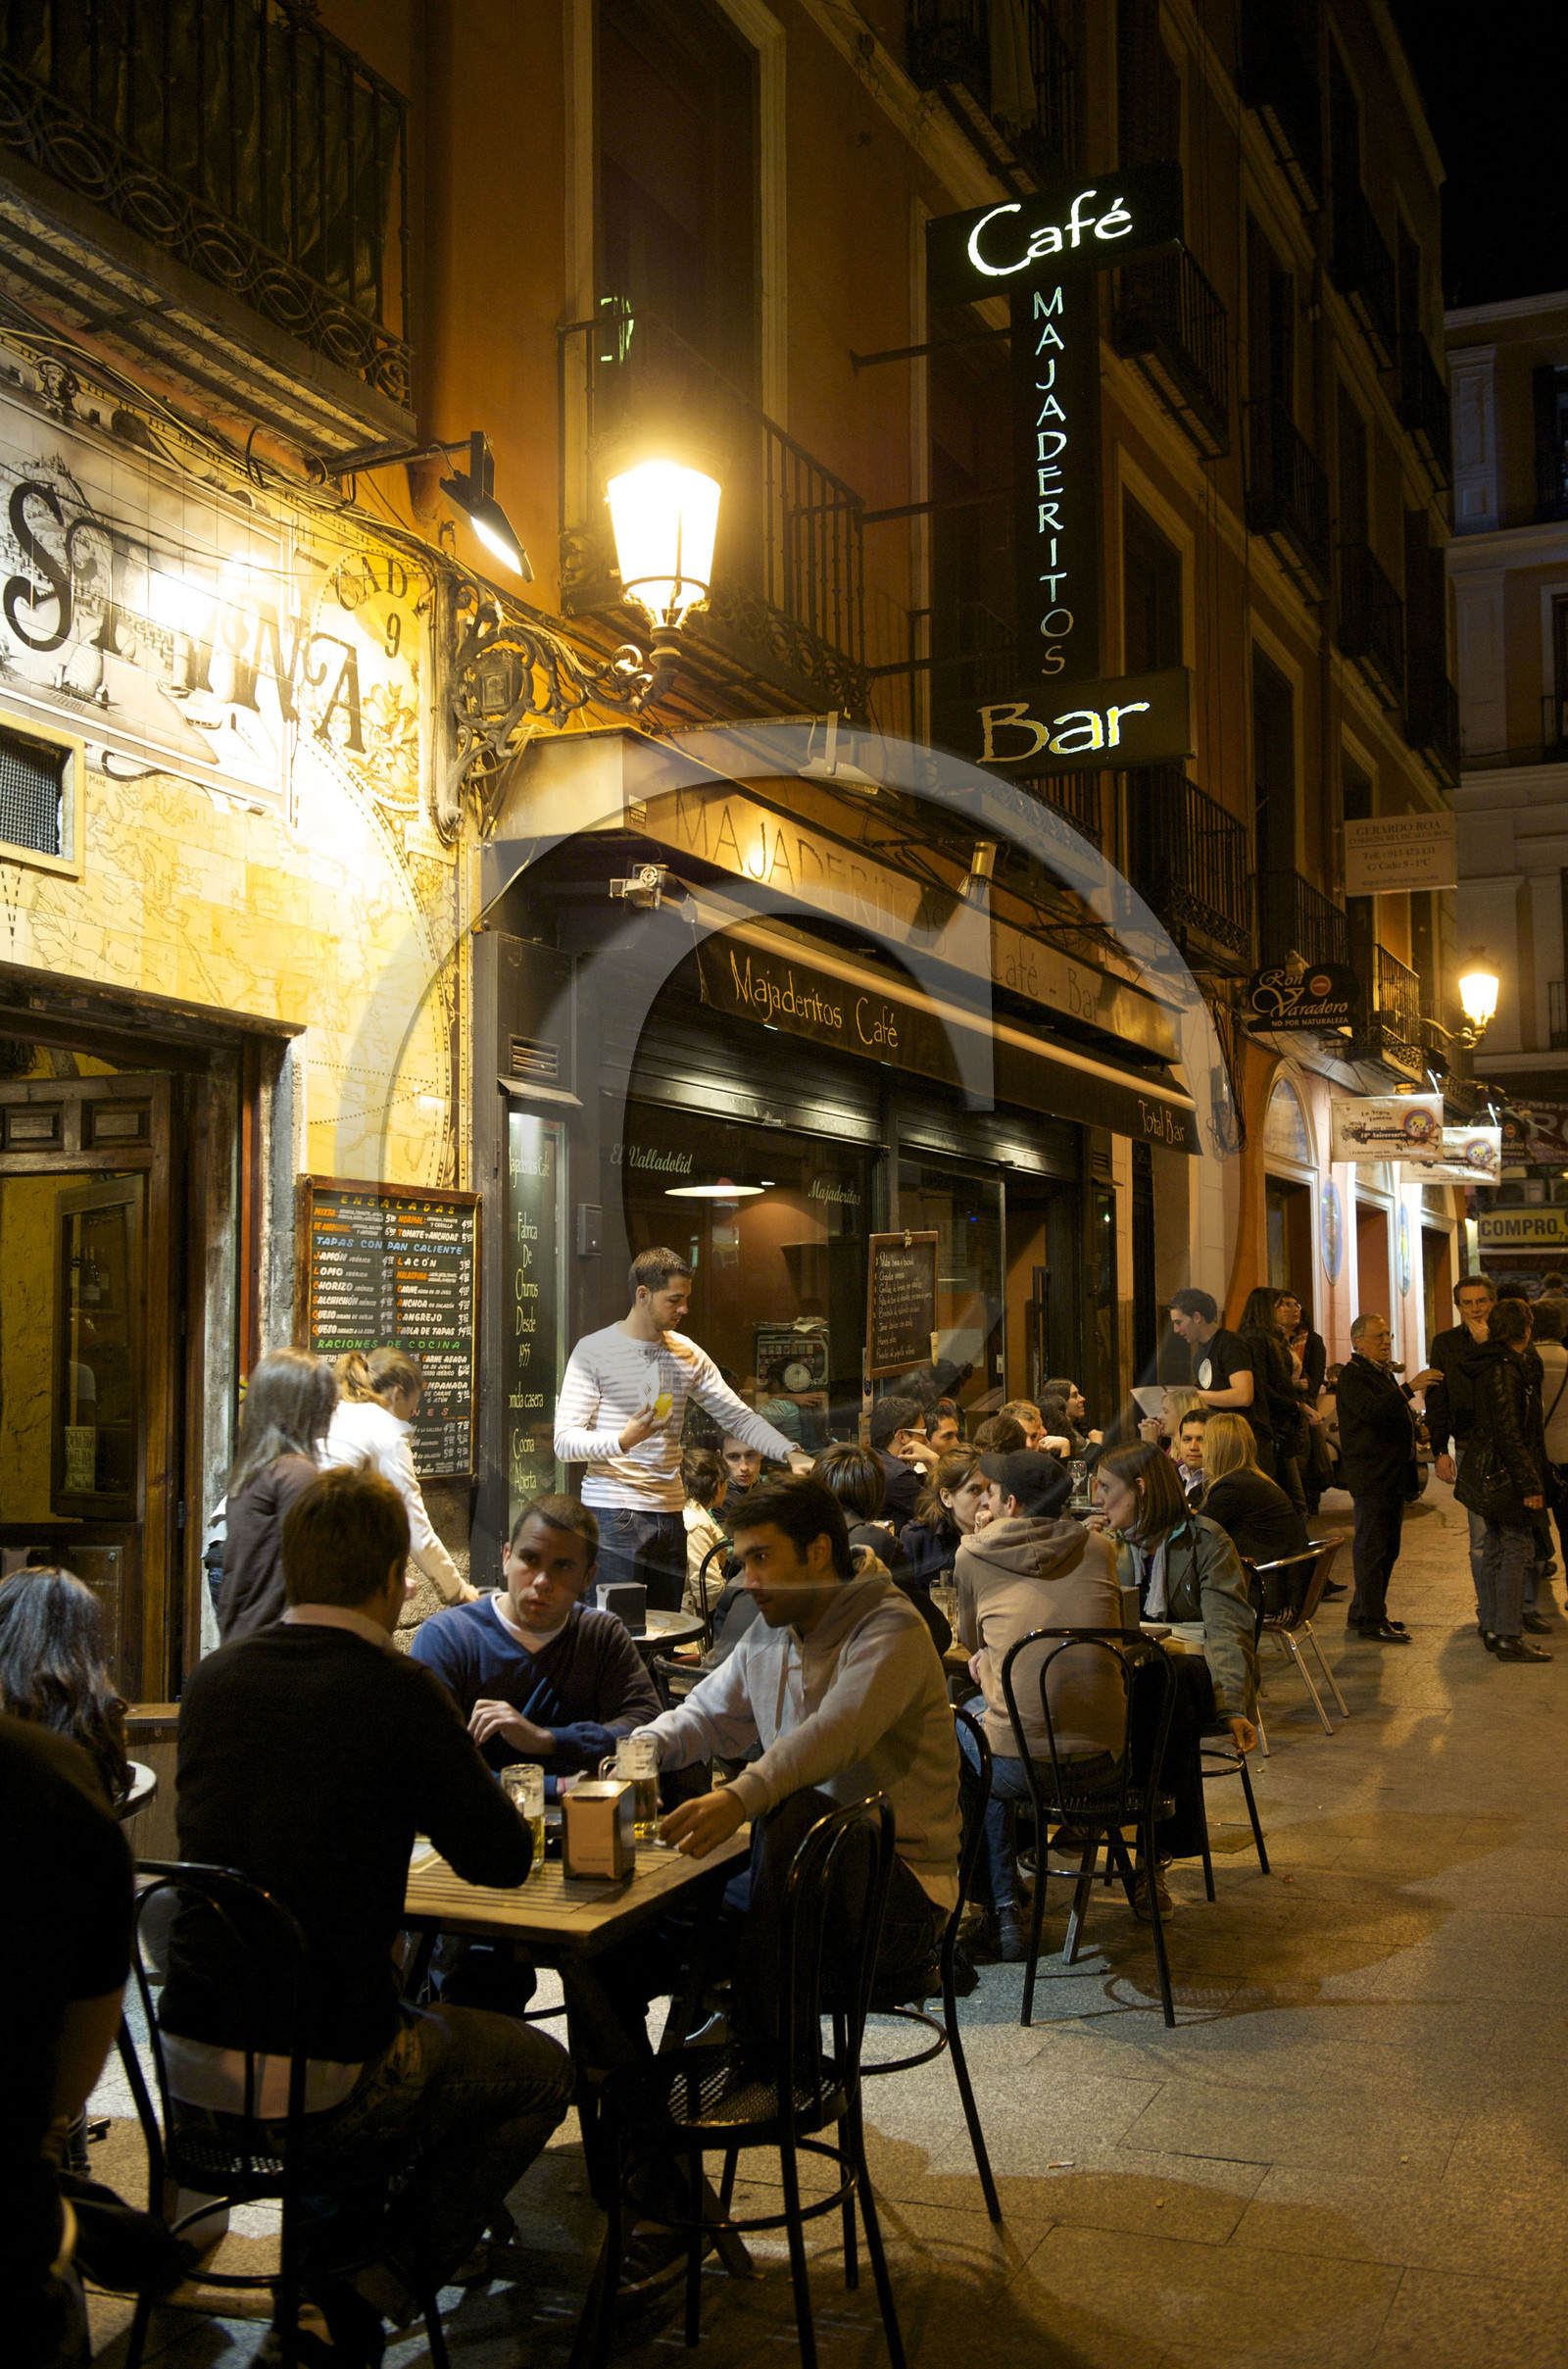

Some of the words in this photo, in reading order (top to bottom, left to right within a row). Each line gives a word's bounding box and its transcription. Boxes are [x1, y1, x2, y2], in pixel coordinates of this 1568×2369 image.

[966, 188, 1134, 277] Café
[1032, 285, 1074, 676] MAJADERITOS
[384, 612, 402, 659] 9
[975, 701, 1152, 765] Bar
[1416, 820, 1442, 831] ROA
[985, 932, 1039, 998] Café
[1067, 965, 1101, 1022] Bar
[1258, 968, 1304, 988] Ron
[729, 949, 843, 1029] Majaderitos
[856, 997, 900, 1049] Café
[1251, 987, 1349, 1018] Varadero
[1285, 1018, 1299, 1027] POR
[1301, 1016, 1349, 1025] NATURALEZA
[1138, 1098, 1164, 1137] Total
[1165, 1110, 1186, 1145] Bar
[610, 1143, 625, 1165] El
[628, 1145, 694, 1175] Valladolid
[808, 1179, 862, 1207] Majaderitos
[340, 1195, 456, 1215] ENSALADAS
[397, 1228, 425, 1240] TOMATE
[1481, 1218, 1559, 1238] COMPRO
[316, 1236, 354, 1248] TAPAS
[360, 1239, 383, 1250] CON
[386, 1241, 409, 1252] PAN
[413, 1243, 464, 1256] CALIENTE
[522, 1243, 532, 1268] De
[313, 1251, 348, 1262] JAMÓN
[397, 1256, 437, 1268] LACÓN
[313, 1265, 343, 1277] LOMO
[313, 1280, 354, 1292] CHORIZO
[396, 1298, 428, 1308] ANCHOA
[312, 1309, 337, 1322] QUESO
[396, 1312, 443, 1322] CANGREJO
[514, 1305, 536, 1336] Desde
[311, 1323, 338, 1337] QUESO
[317, 1339, 378, 1350] RACIONES
[386, 1339, 403, 1350] DE
[408, 1340, 461, 1350] COCINA
[422, 1381, 468, 1391] EMPANADA
[513, 1427, 535, 1460] Cocina
